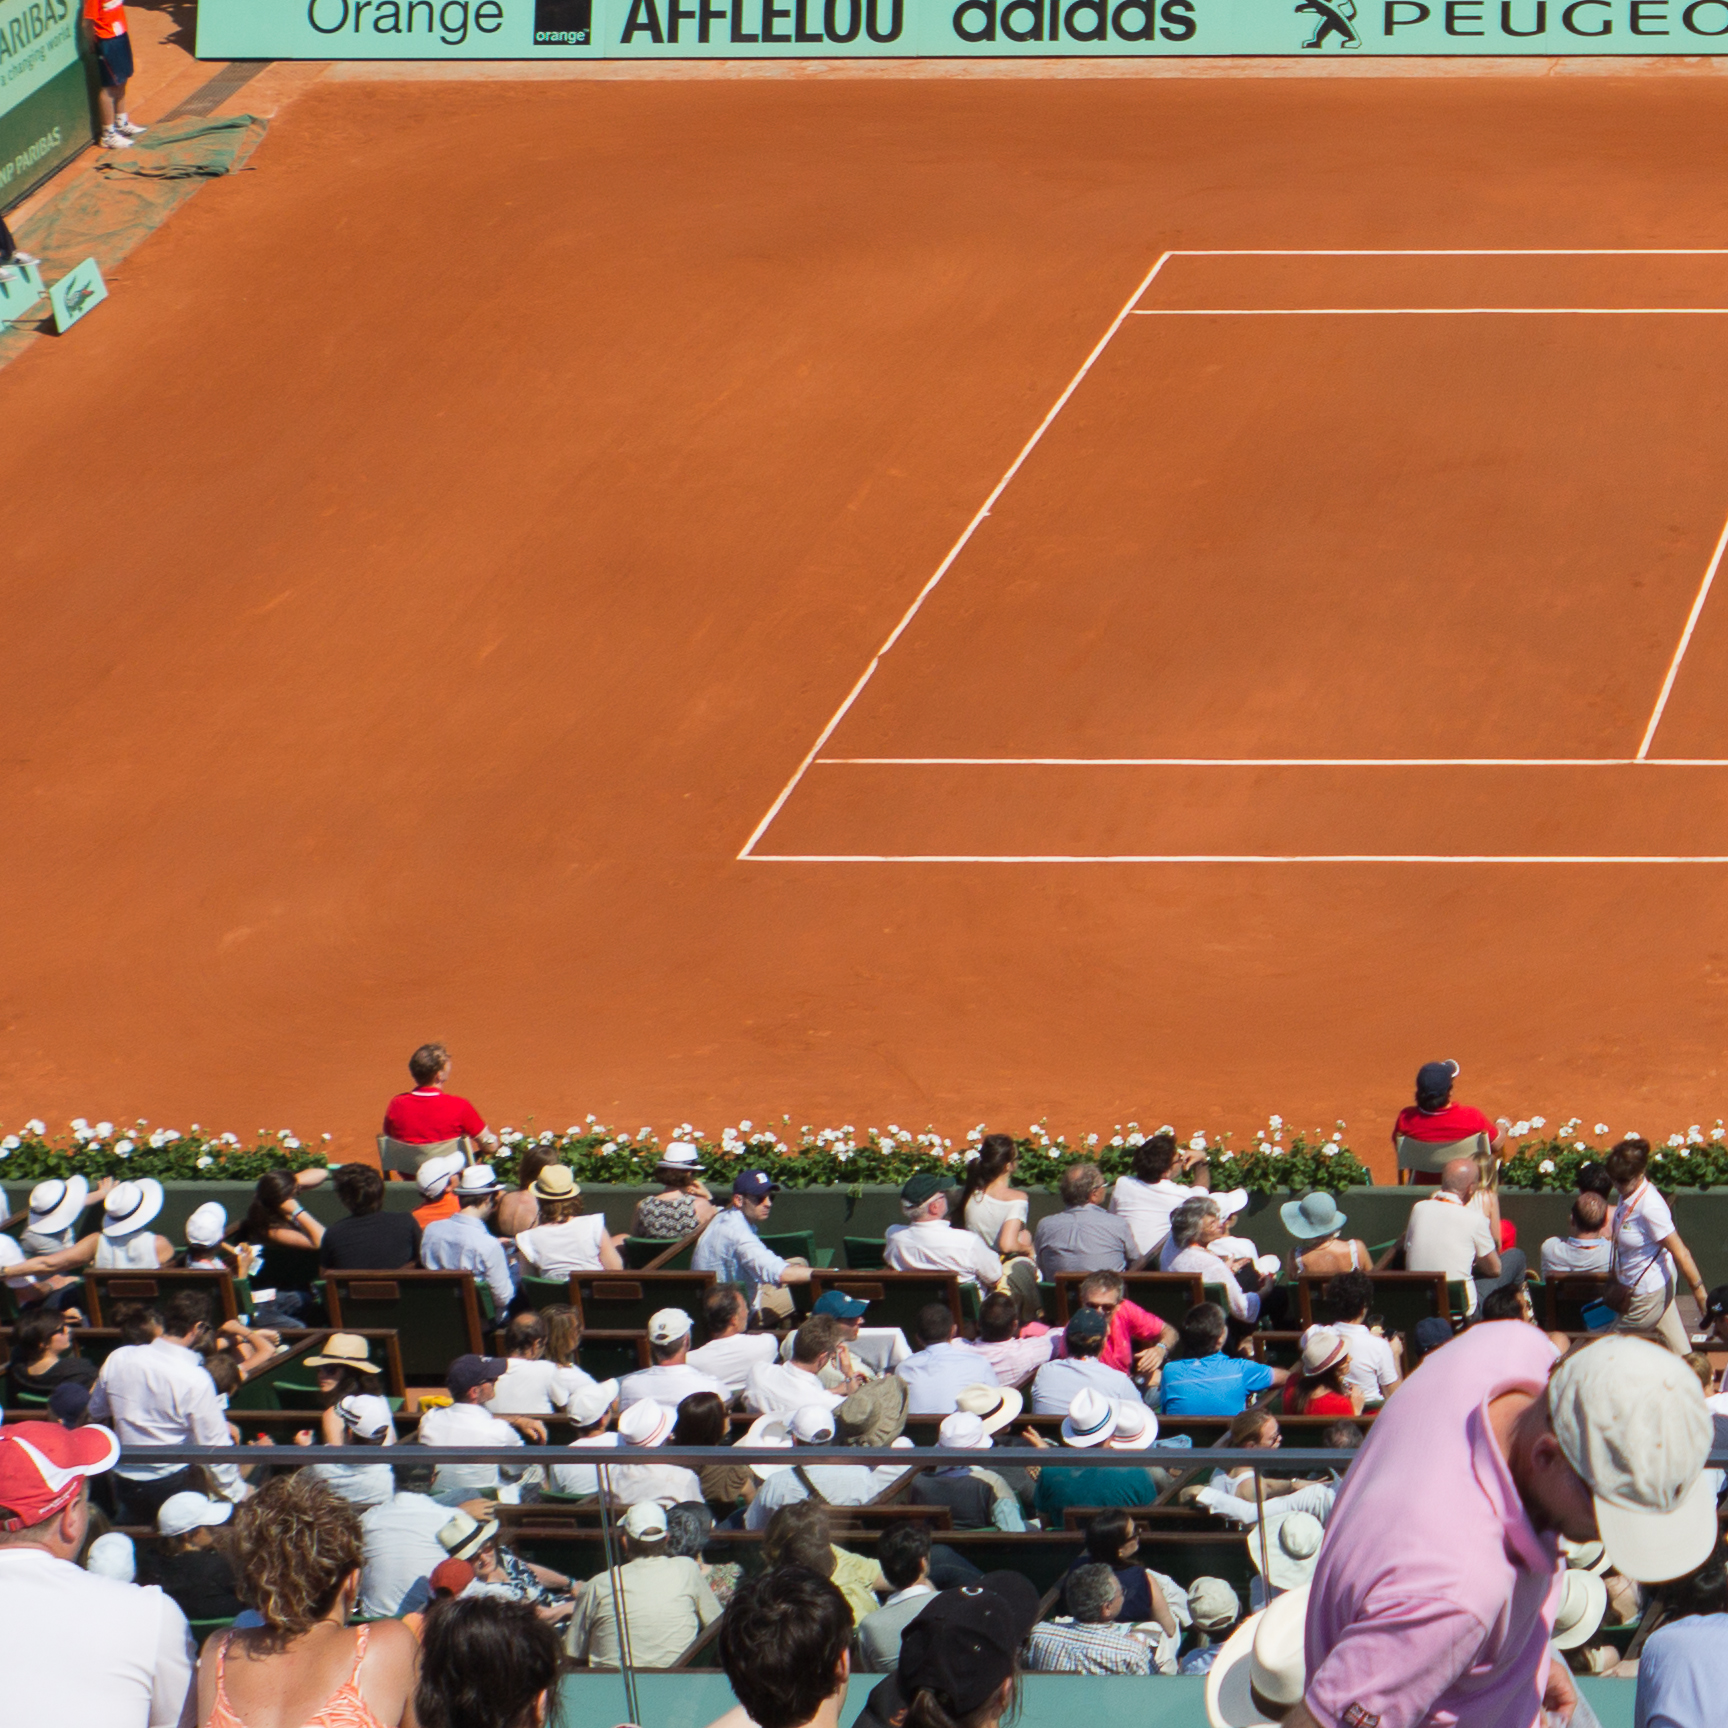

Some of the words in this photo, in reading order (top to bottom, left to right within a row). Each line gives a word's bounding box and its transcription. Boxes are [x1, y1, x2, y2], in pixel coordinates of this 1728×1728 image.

[8, 46, 46, 81] changing
[46, 23, 71, 52] world
[535, 30, 586, 45] orange
[15, 126, 61, 174] PARIBAS
